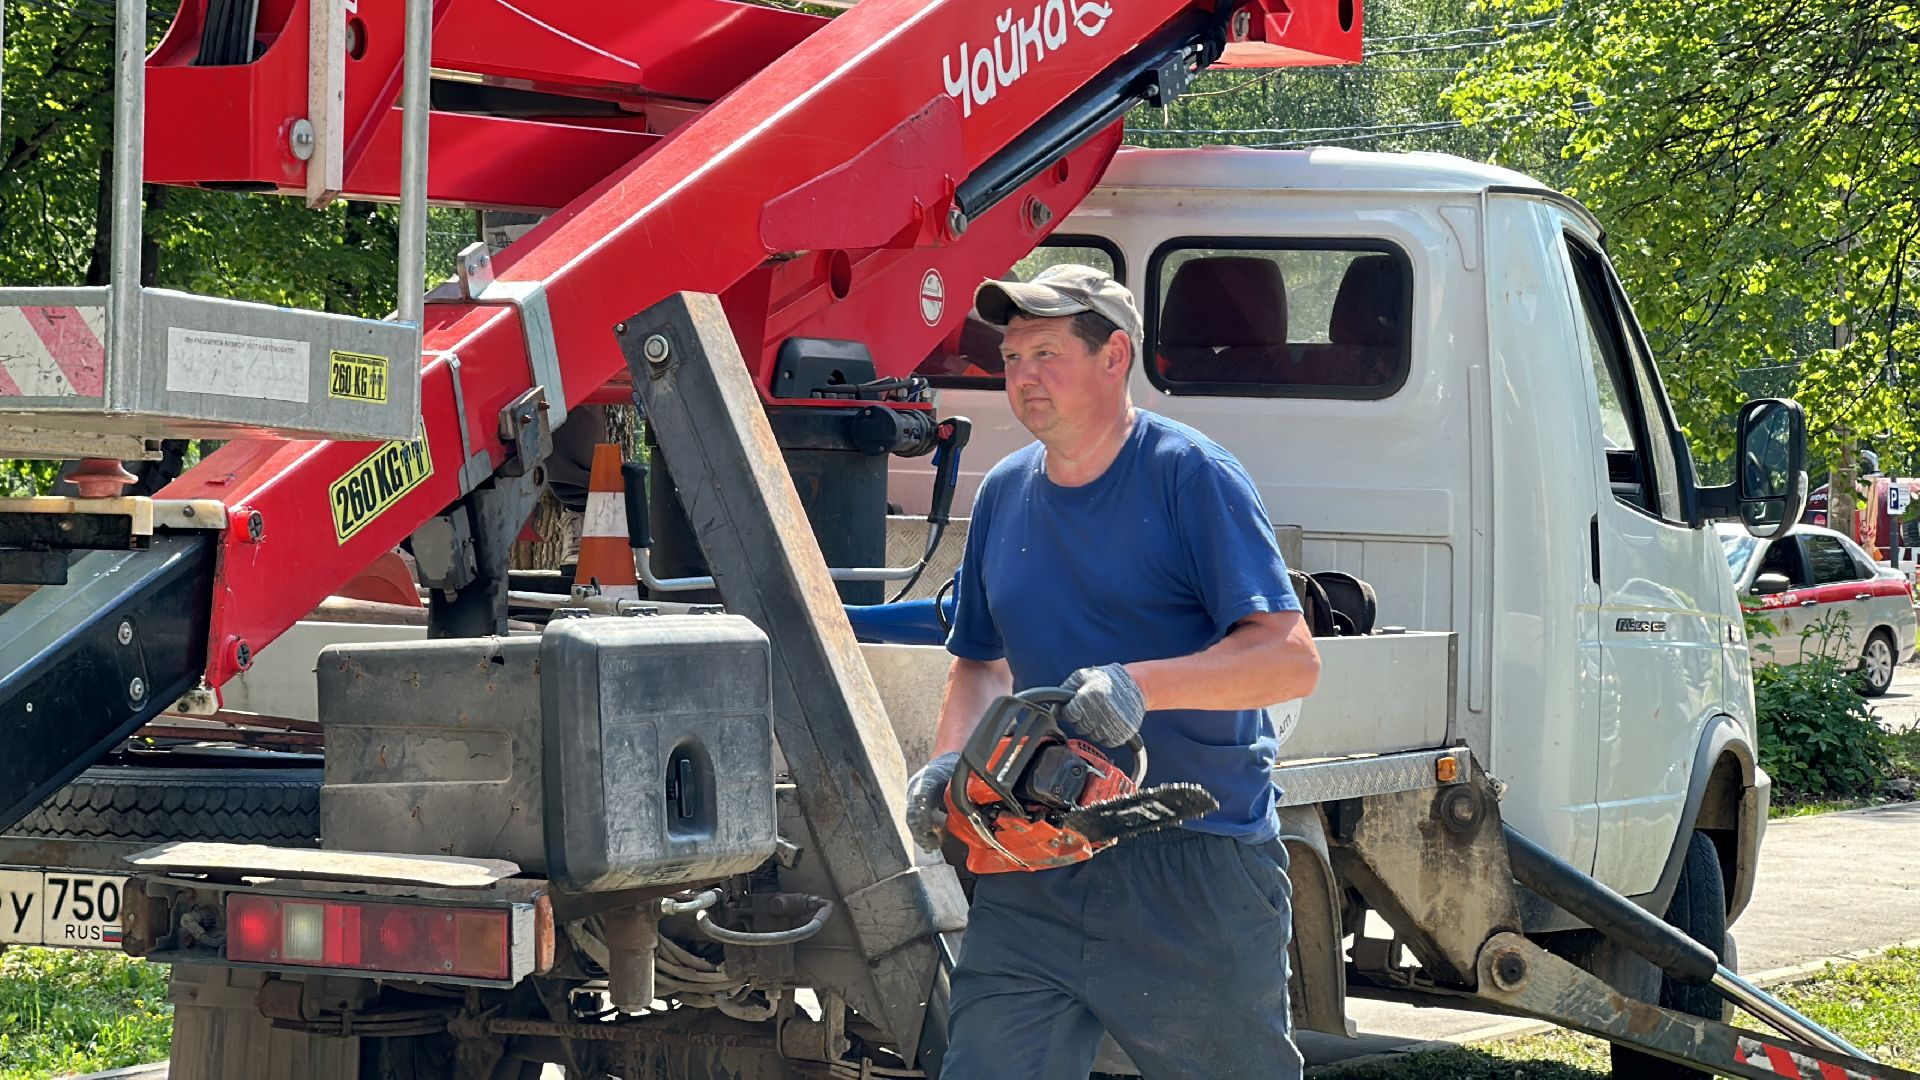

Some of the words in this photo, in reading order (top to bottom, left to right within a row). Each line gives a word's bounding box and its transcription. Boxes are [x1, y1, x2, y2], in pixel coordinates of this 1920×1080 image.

[333, 363, 351, 393] 260
[355, 366, 367, 396] KG
[336, 467, 376, 532] 260
[374, 446, 404, 502] KG
[1891, 490, 1897, 507] P
[0, 891, 34, 933] У
[48, 878, 120, 922] 750
[65, 924, 100, 940] RUS
